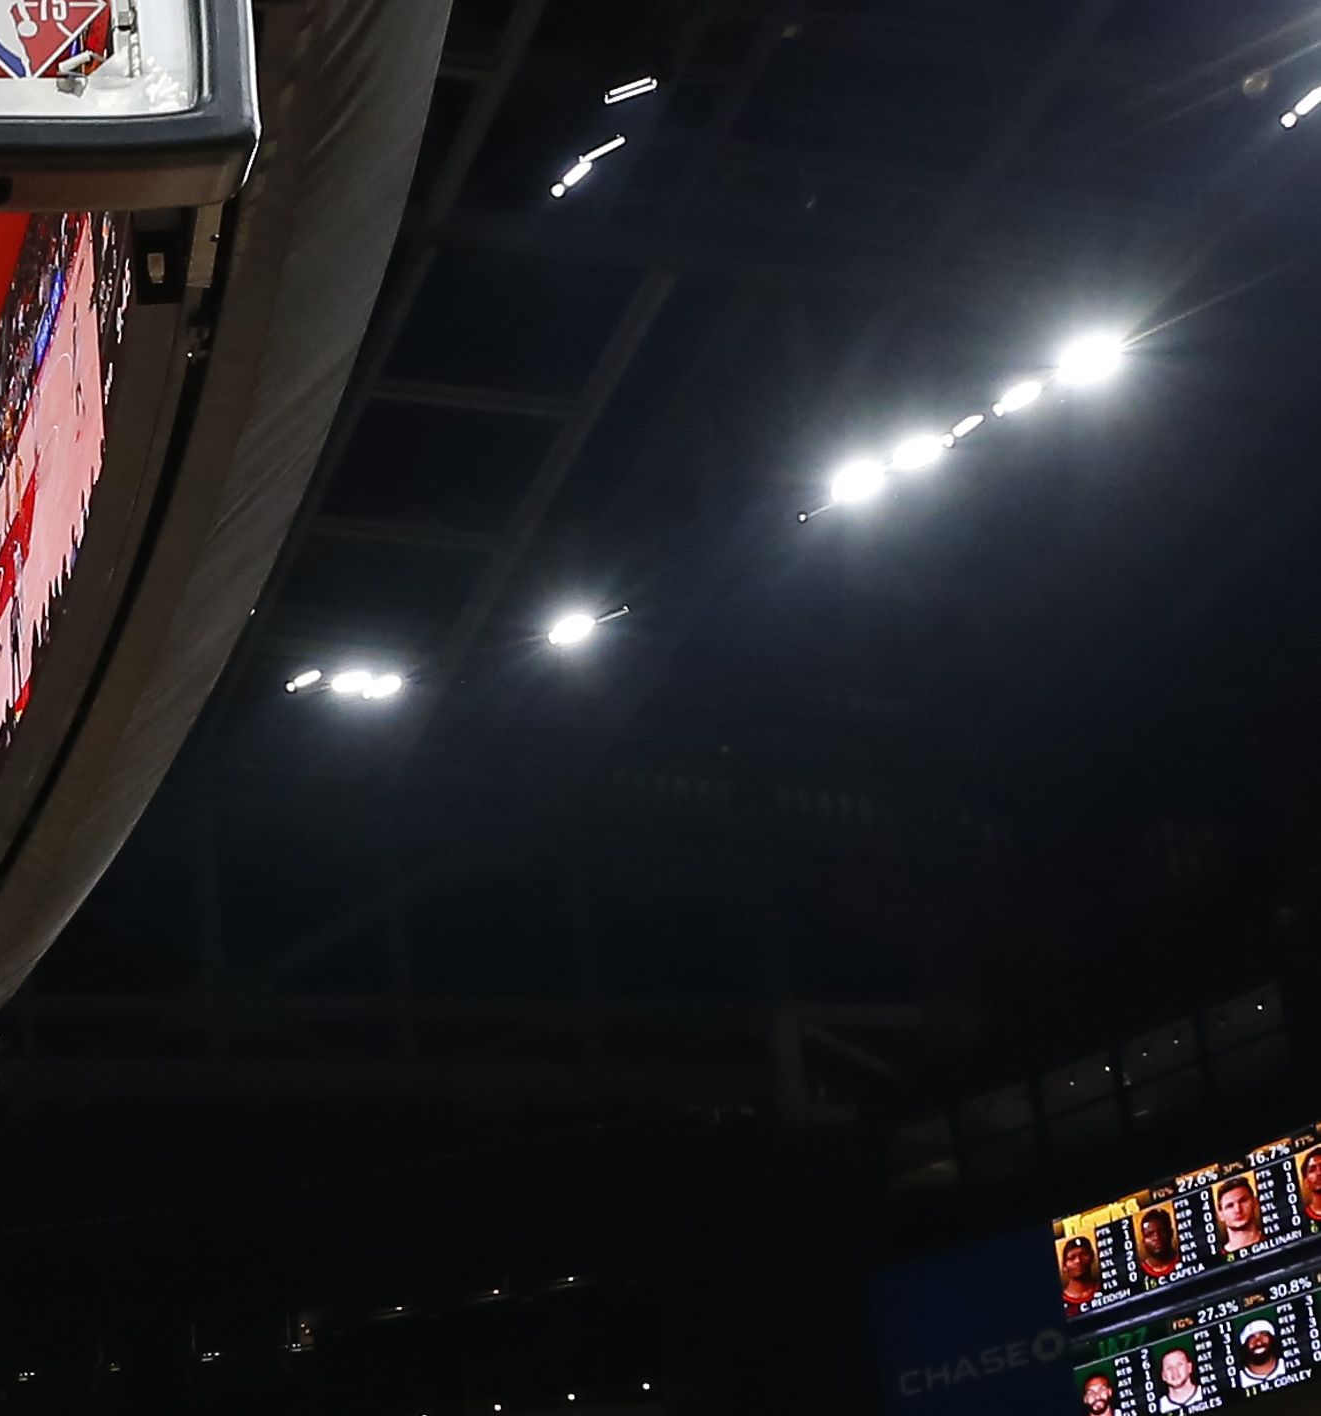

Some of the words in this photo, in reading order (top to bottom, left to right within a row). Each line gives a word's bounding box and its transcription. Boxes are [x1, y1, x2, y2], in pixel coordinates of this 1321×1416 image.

[1176, 1171, 1218, 1193] 27.6%
[1247, 1144, 1291, 1167] 16.7%
[1197, 1300, 1239, 1323] 27.3%
[1269, 1276, 1312, 1300] 30.8%
[899, 1339, 1030, 1396] CHASE
